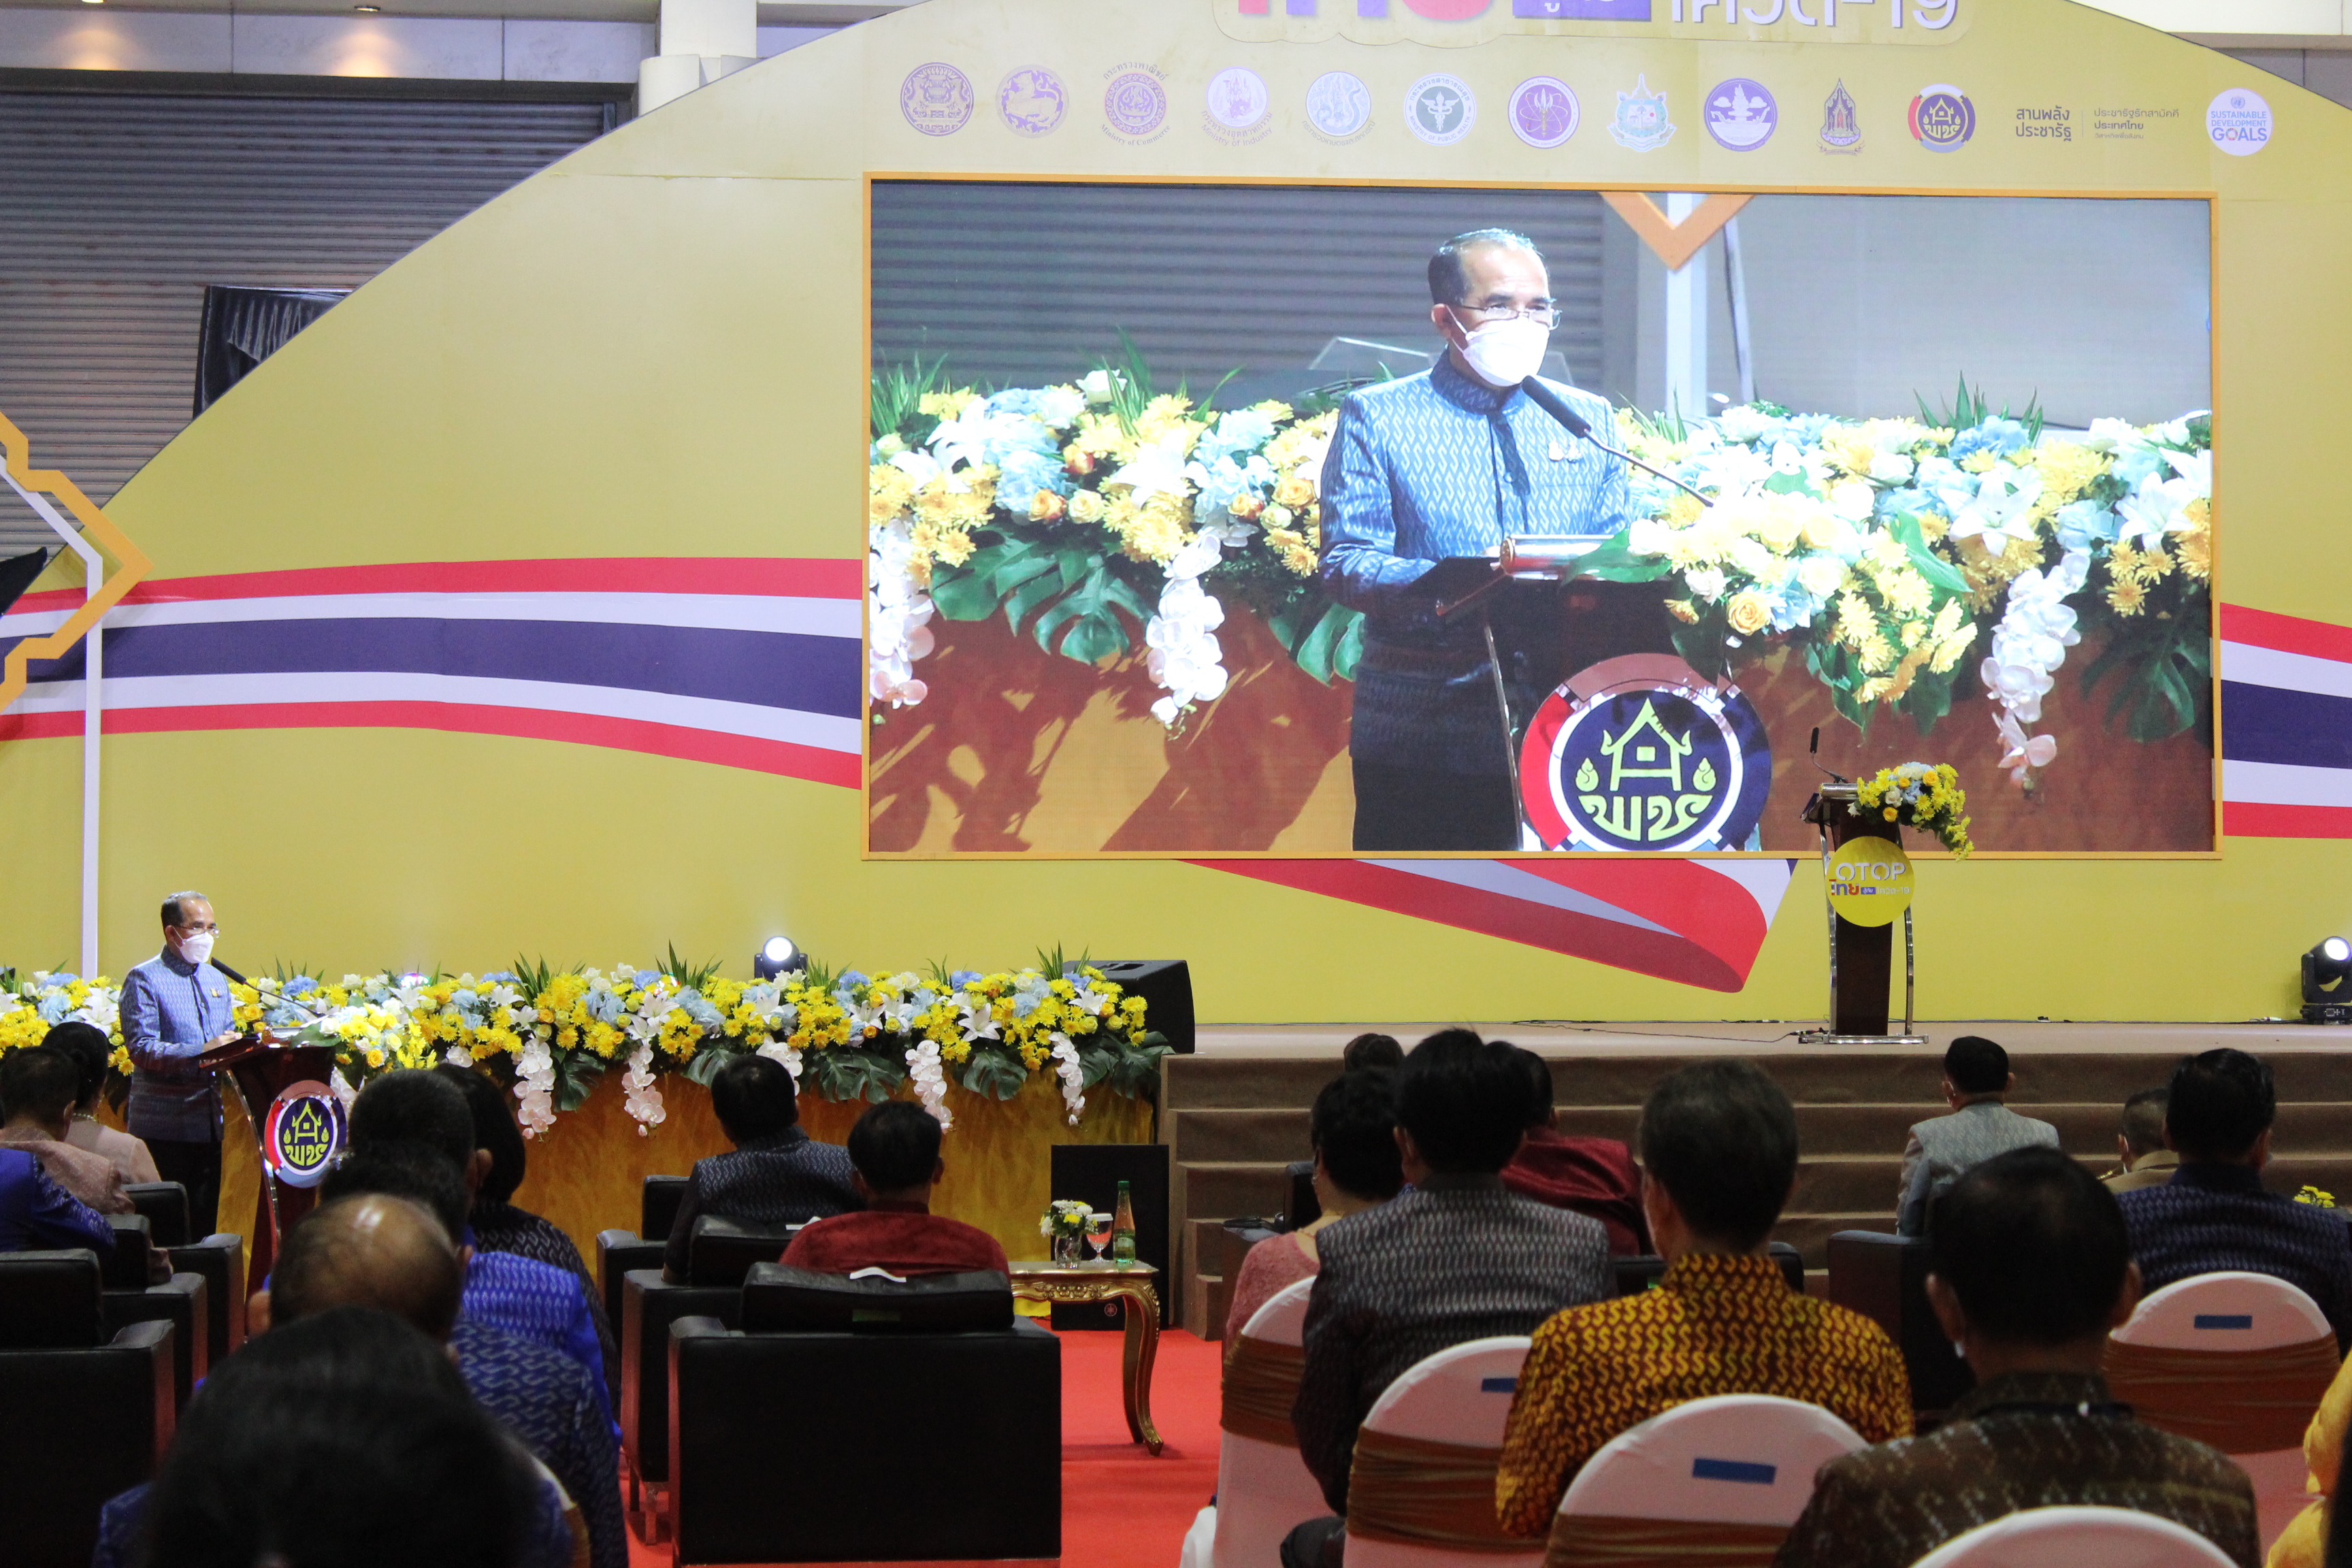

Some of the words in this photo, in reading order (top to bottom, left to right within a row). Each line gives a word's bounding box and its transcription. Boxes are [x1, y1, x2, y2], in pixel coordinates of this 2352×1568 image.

[2016, 105, 2070, 120] สานพลัง
[2093, 108, 2179, 119] ประชารัฐรักสามัคคี
[2015, 122, 2072, 142] ประชารัฐ
[2094, 120, 2144, 130] ประเทศไทย
[1100, 123, 1126, 145] Ministry
[1137, 125, 1171, 145] Commerce
[1201, 125, 1230, 146] Ministry
[1243, 127, 1273, 146] Industry
[1437, 133, 1457, 142] PUBLIC
[2212, 127, 2268, 142] GOALS
[1835, 862, 1906, 881] OTOP
[1829, 879, 1859, 896] ไทย
